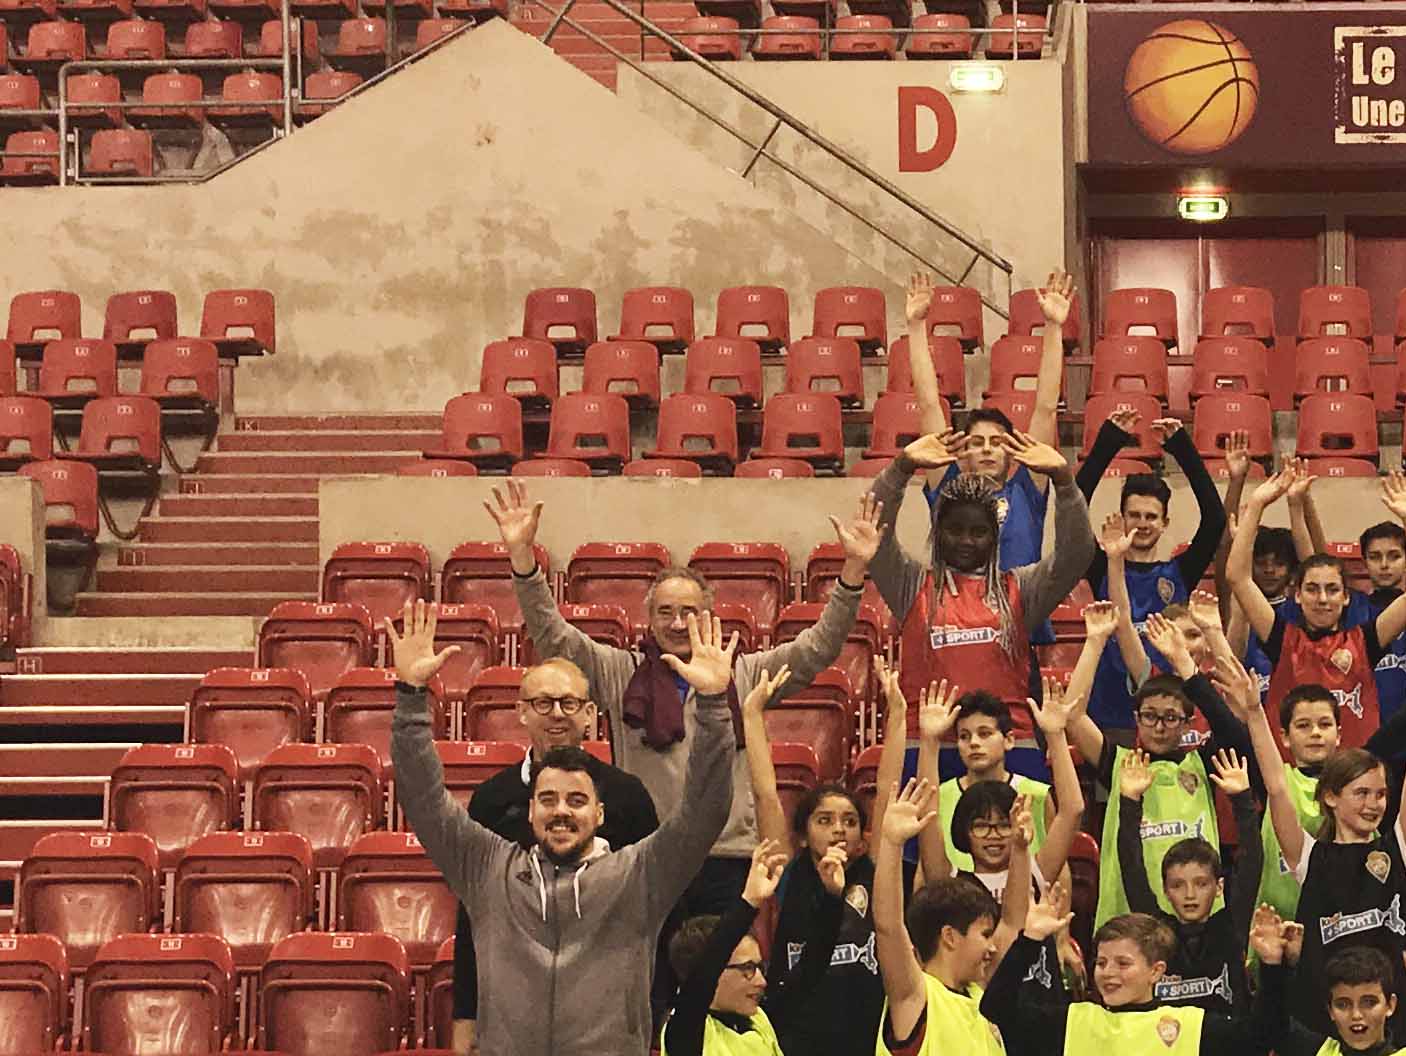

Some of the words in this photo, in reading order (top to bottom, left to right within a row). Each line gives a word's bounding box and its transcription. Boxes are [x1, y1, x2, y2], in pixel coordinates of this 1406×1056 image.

[1352, 42, 1396, 85] Le
[898, 86, 958, 173] D
[1352, 96, 1405, 127] Une
[23, 659, 36, 672] H
